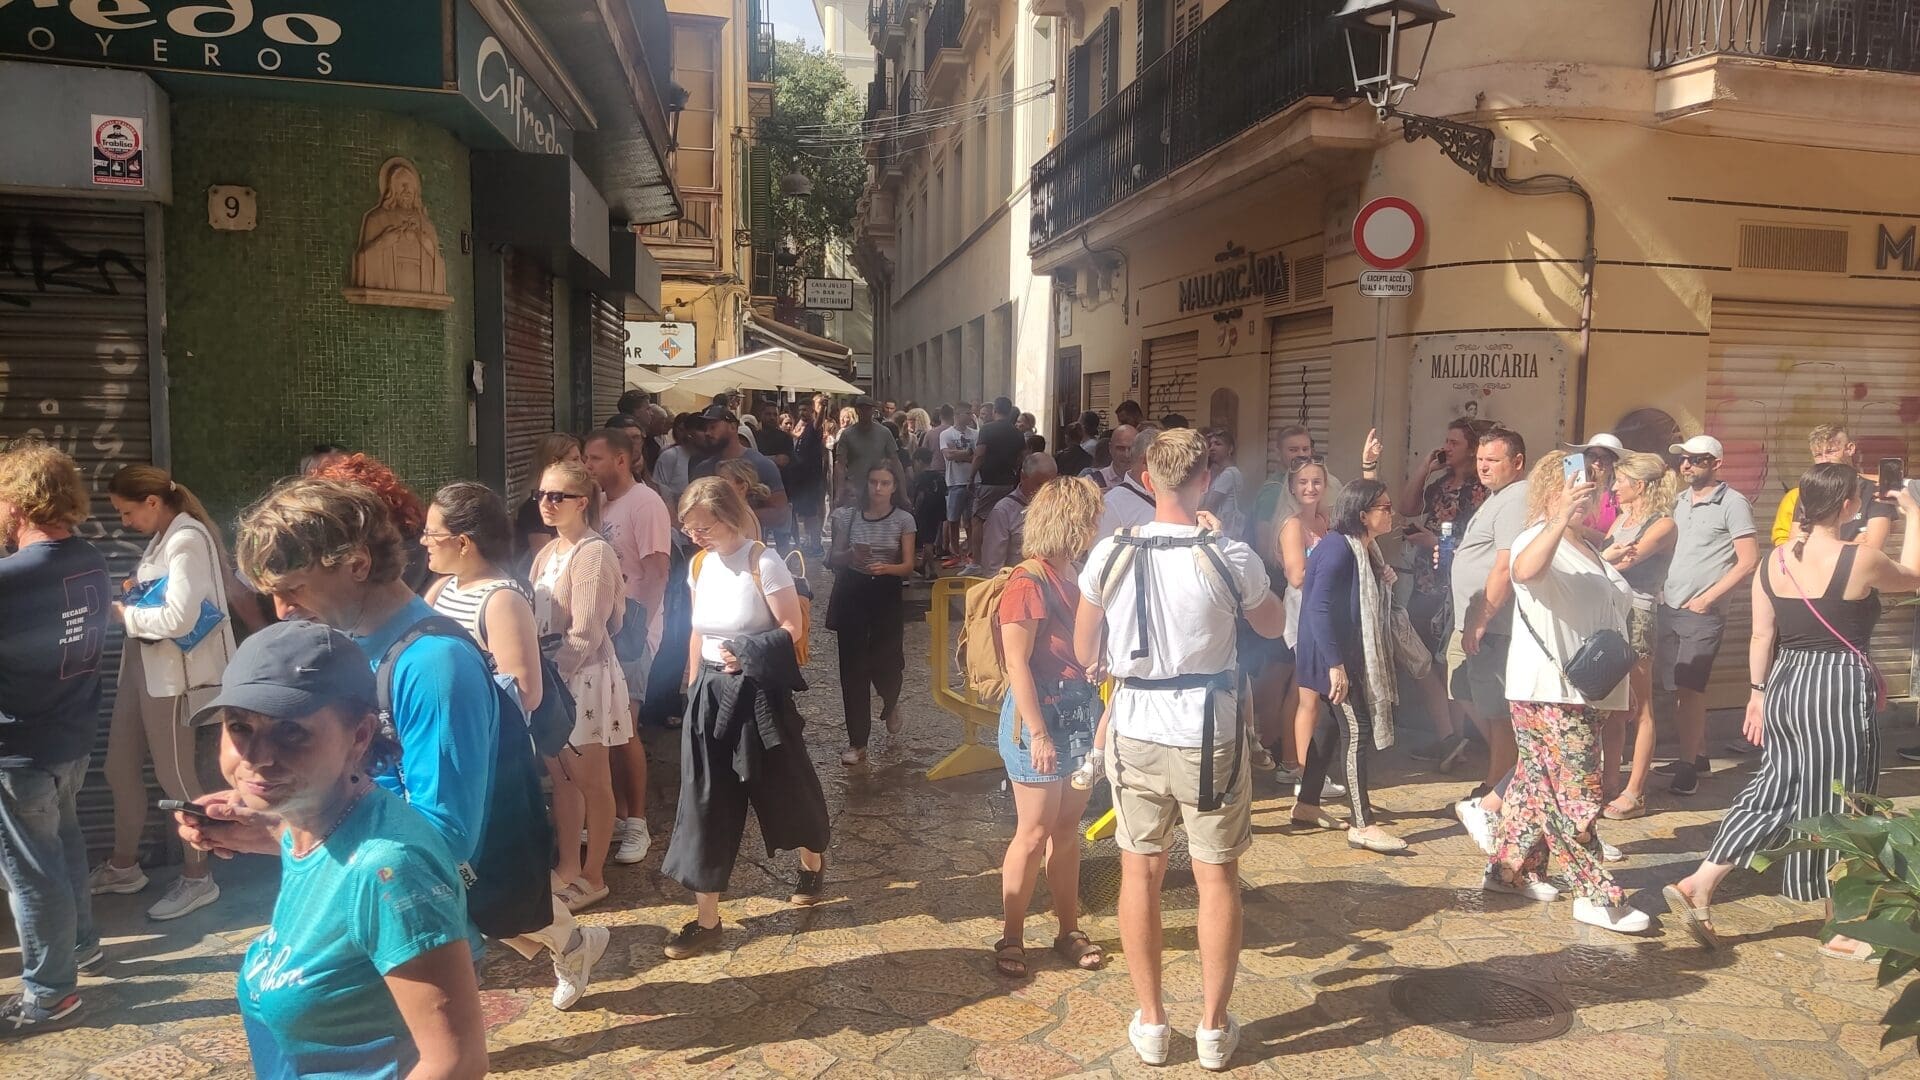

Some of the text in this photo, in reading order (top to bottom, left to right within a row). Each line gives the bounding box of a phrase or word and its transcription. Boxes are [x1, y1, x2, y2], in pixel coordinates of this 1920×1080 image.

[0, 0, 341, 45] edo
[28, 27, 333, 75] OYEROS
[102, 139, 133, 148] Trablisa
[225, 196, 240, 219] 9
[1876, 223, 1920, 271] M
[1179, 251, 1287, 312] MALLORCARIA
[1431, 353, 1538, 378] MALLORCARIA
[59, 633, 85, 645] PLANET
